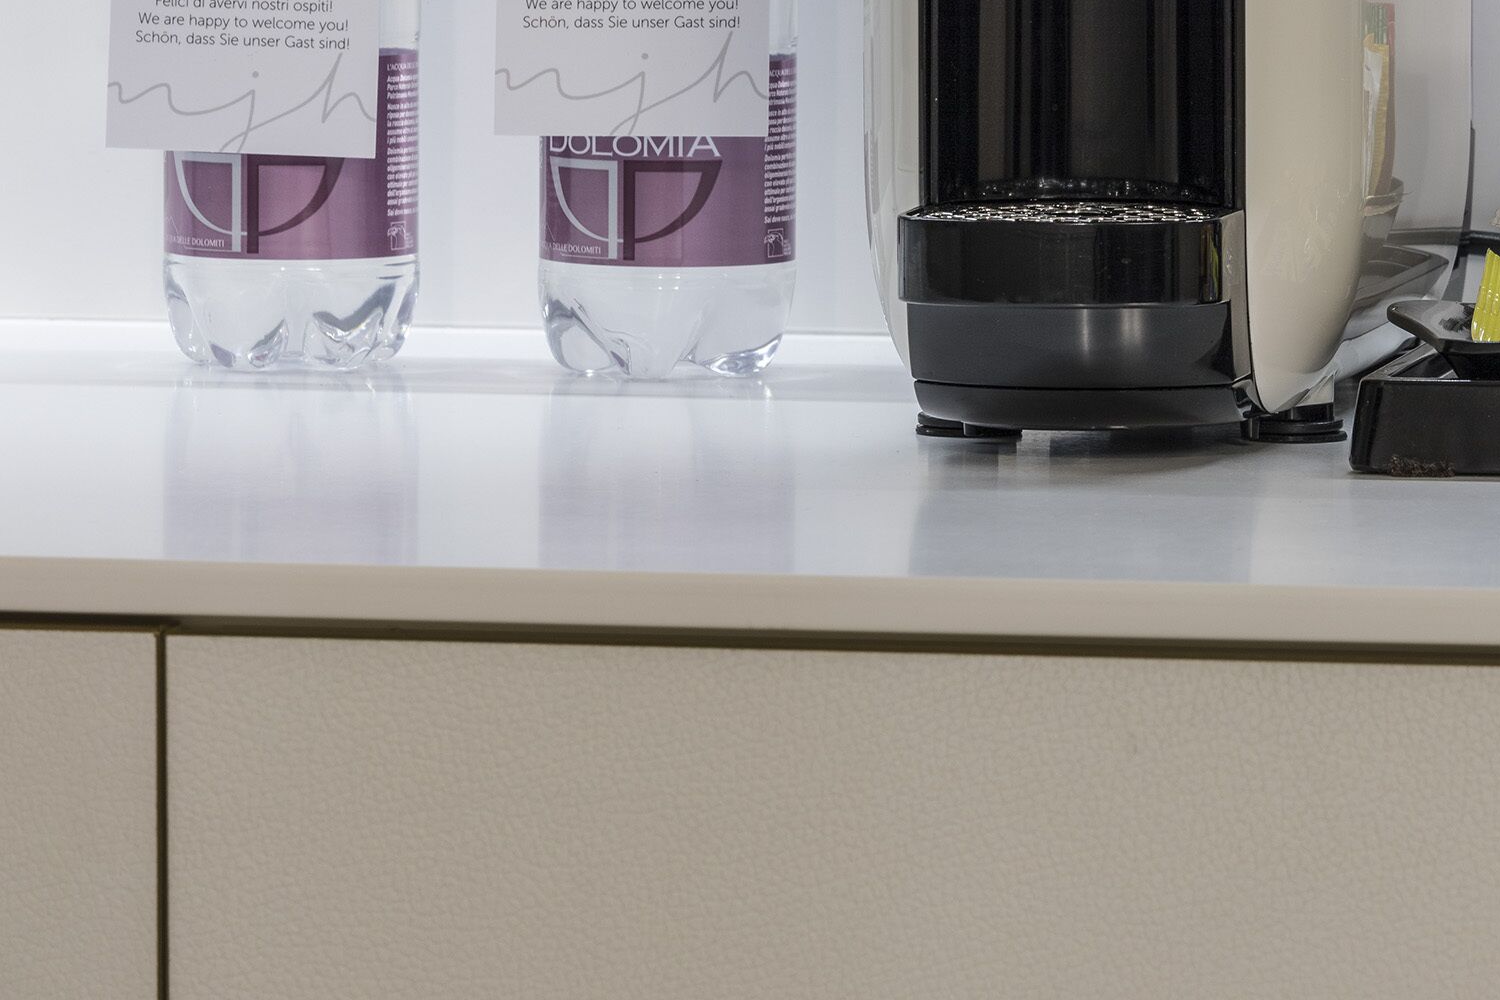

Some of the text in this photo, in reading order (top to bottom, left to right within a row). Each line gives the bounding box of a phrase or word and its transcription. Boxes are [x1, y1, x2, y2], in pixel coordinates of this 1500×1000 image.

[292, 0, 333, 15] ospiti!
[549, 0, 573, 11] are
[138, 12, 349, 35] We are happy to welcome you!
[522, 14, 741, 32] Schön, dass Sie unser Gast sind!
[135, 29, 350, 51] Schön, dass Sie unser Gast sind!
[191, 238, 225, 248] DOLOMITI
[568, 244, 601, 255] DOLOMITI
